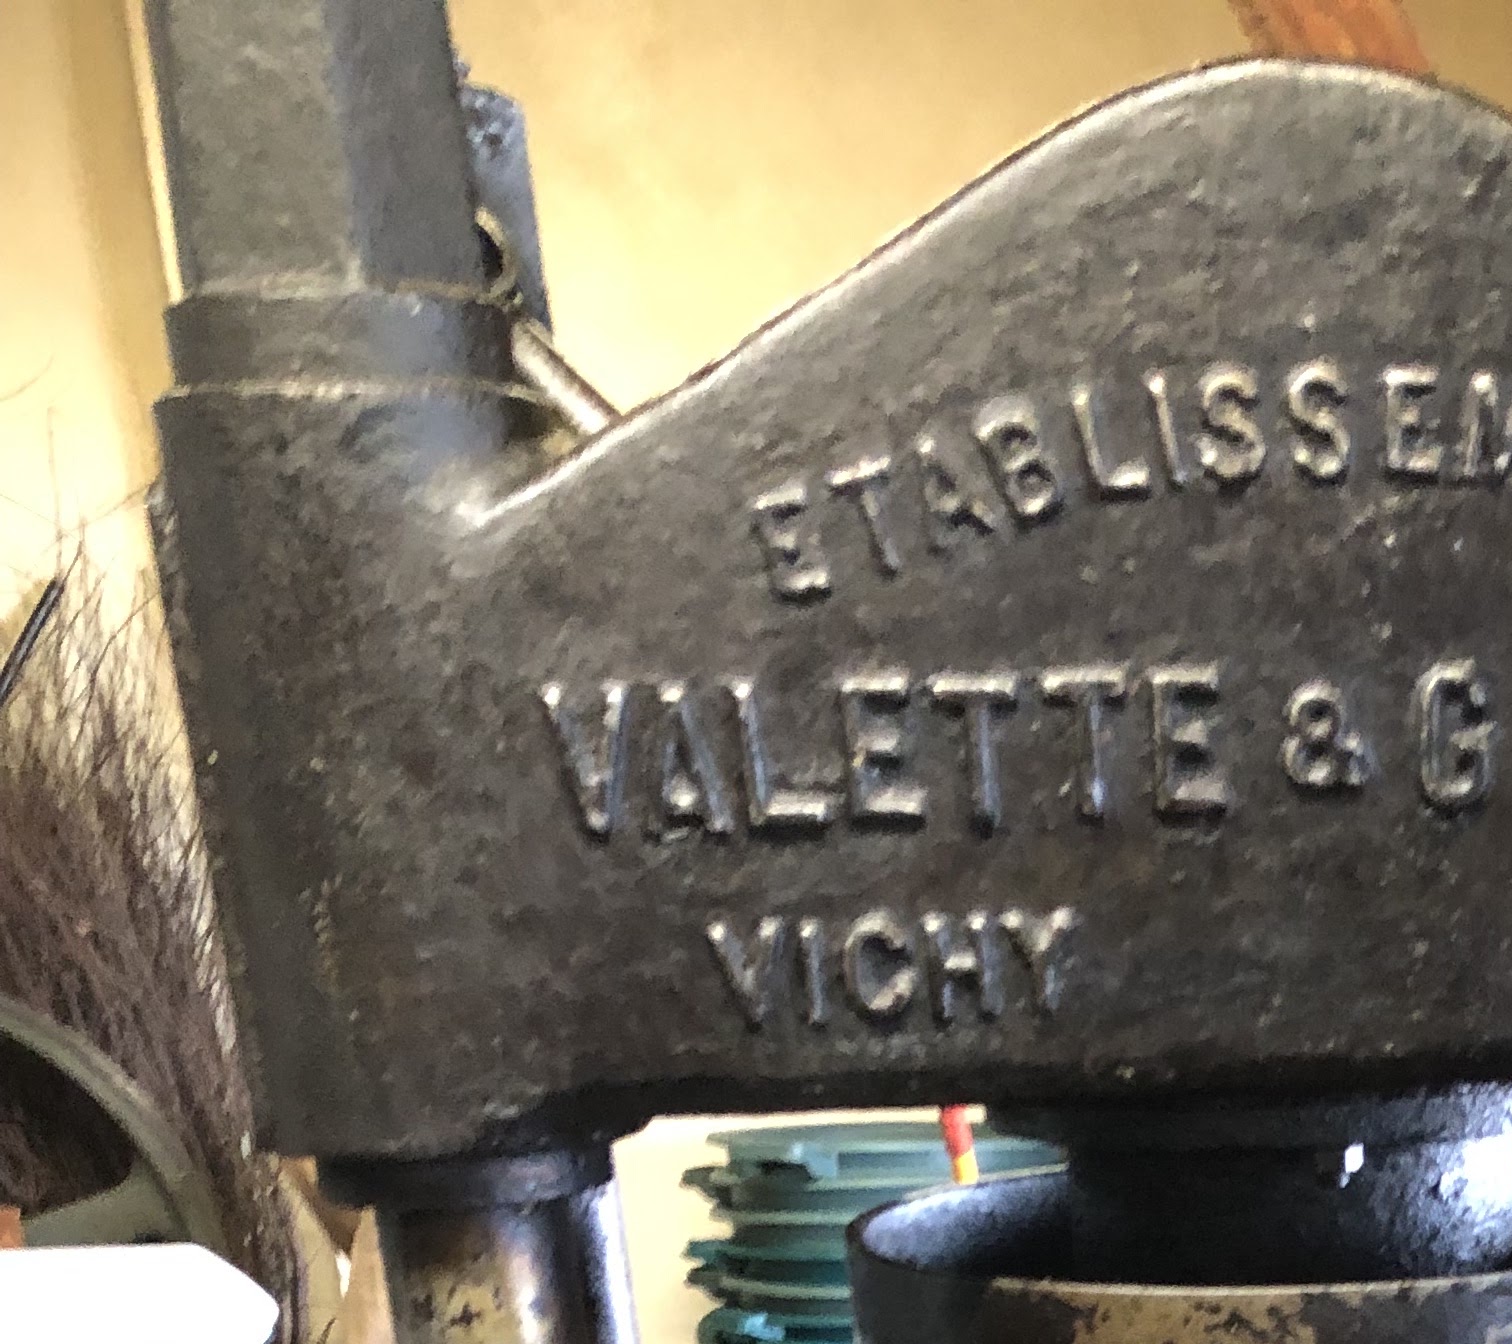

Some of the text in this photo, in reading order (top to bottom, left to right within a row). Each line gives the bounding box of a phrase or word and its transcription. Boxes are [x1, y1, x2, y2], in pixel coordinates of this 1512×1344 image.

[540, 660, 1232, 840] VALETTE
[1280, 677, 1378, 788] &
[706, 906, 1078, 1028] VICHY
